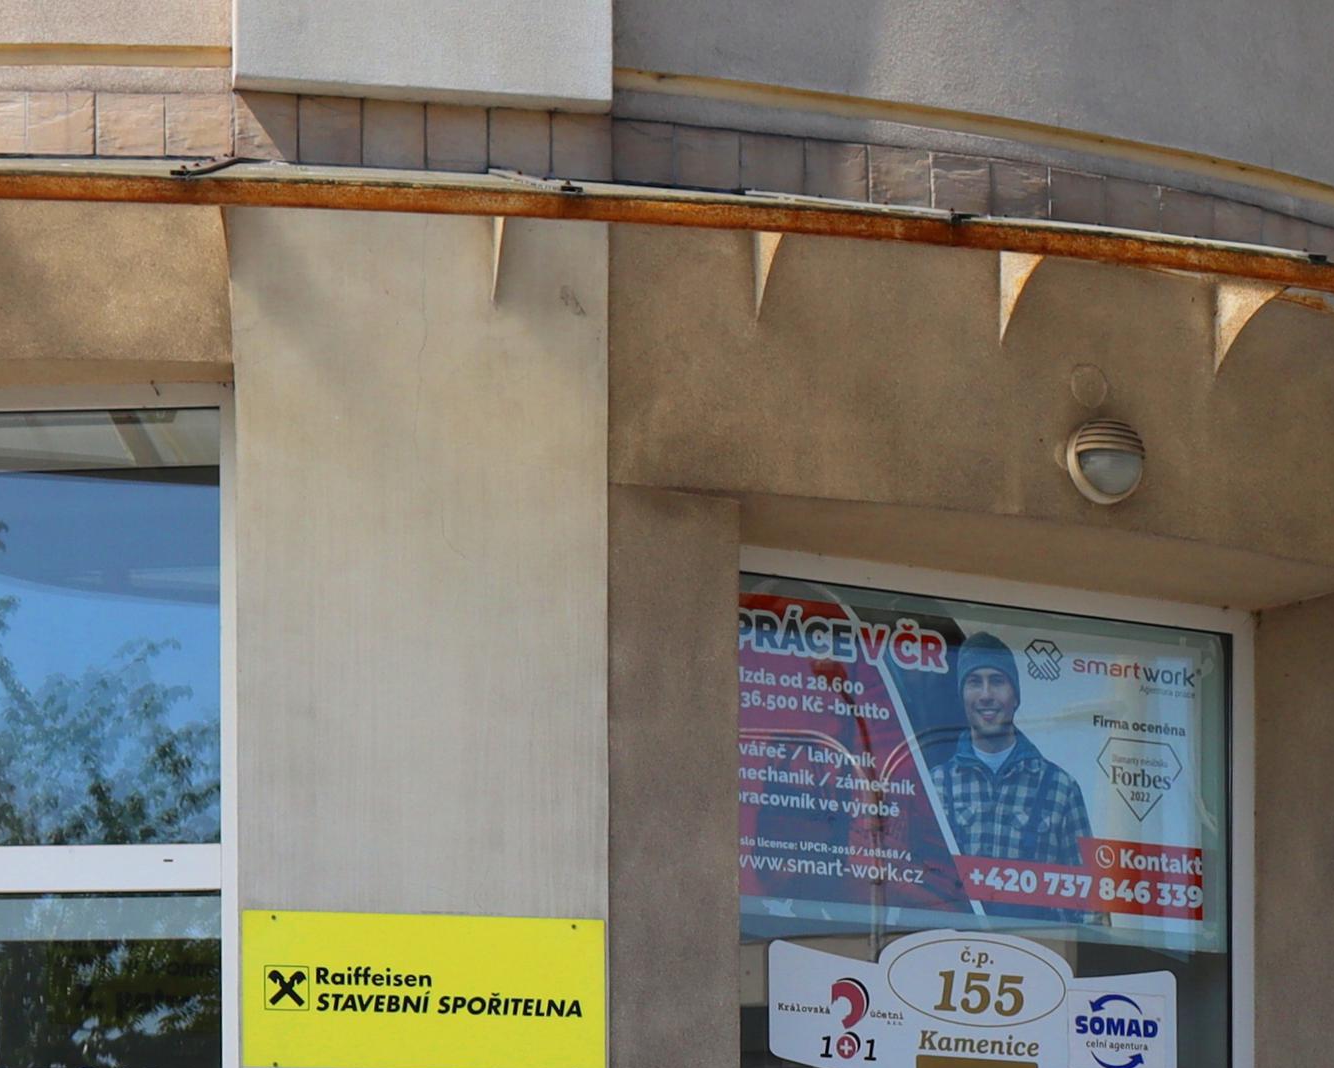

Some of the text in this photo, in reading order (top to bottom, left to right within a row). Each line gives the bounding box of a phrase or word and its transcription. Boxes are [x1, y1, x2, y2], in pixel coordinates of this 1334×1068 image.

[859, 626, 886, 660] V
[893, 623, 945, 668] ČR
[780, 671, 803, 689] od
[806, 676, 865, 695] 28.600
[1072, 658, 1196, 687] smartwork
[740, 690, 798, 711] 36.500
[802, 694, 824, 713] Kč
[1092, 714, 1186, 737] Firma oceněna
[738, 741, 787, 759] vářeč
[1110, 765, 1172, 790] Forbes
[1130, 790, 1151, 803] 2022
[818, 800, 839, 812] ve
[842, 799, 900, 818] výrobě
[739, 836, 756, 847] slo
[757, 837, 798, 850] licence:
[739, 853, 924, 884] www.smart-work.cz
[1120, 849, 1203, 876] Kontakt
[969, 867, 1203, 909] +420 737 846 339
[960, 946, 994, 968] č.p.
[315, 966, 433, 988] Raiffeisen
[316, 991, 583, 1018] STAVEBNÍ SPOŘITELNA
[934, 970, 1025, 1017] 155
[778, 1002, 831, 1015] Královská
[1075, 1015, 1158, 1038] SOMAD
[918, 1030, 1040, 1057] Kamenice
[1086, 1038, 1149, 1052] celní agentura
